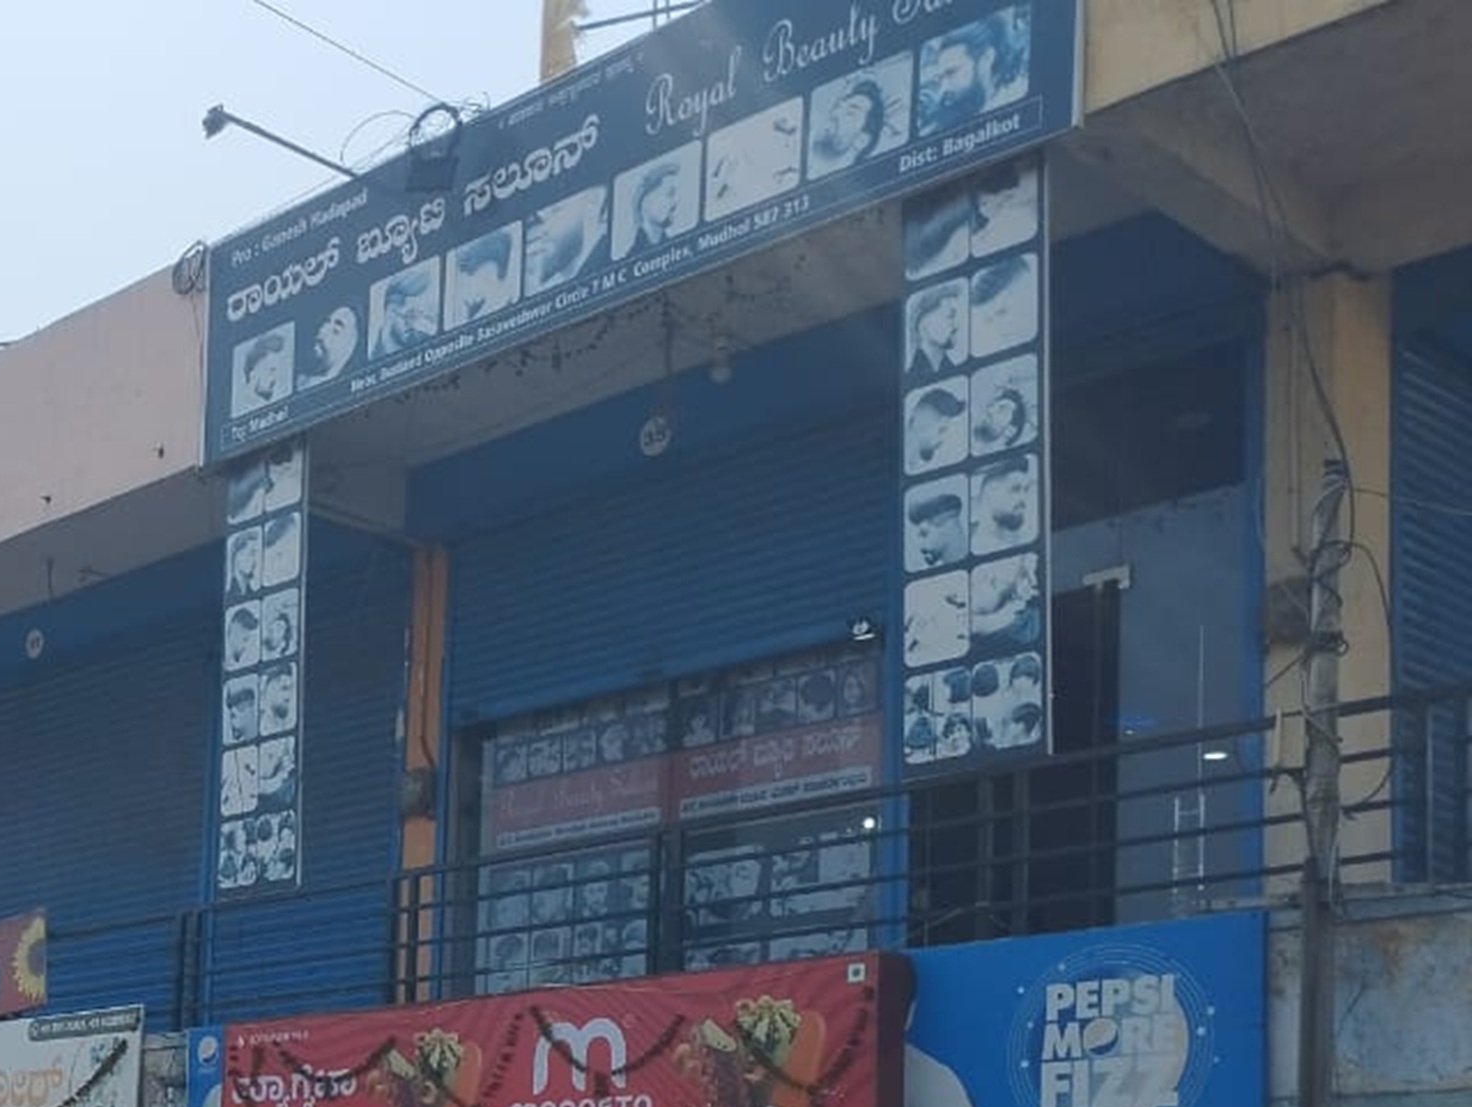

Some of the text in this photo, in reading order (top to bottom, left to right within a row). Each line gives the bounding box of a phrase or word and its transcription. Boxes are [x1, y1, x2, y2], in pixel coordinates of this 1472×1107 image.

[644, 45, 744, 138] Royal
[761, 4, 882, 84] Beauty
[897, 112, 1022, 175] Dist: Bagalkot
[227, 236, 341, 322] ರಾಯಲ್
[462, 113, 601, 218] ಸಲೂನ್
[554, 287, 591, 312] Circle
[696, 217, 753, 251] Mudhol
[1040, 1012, 1179, 1060] MORE
[1045, 972, 1176, 1022] PEPSI
